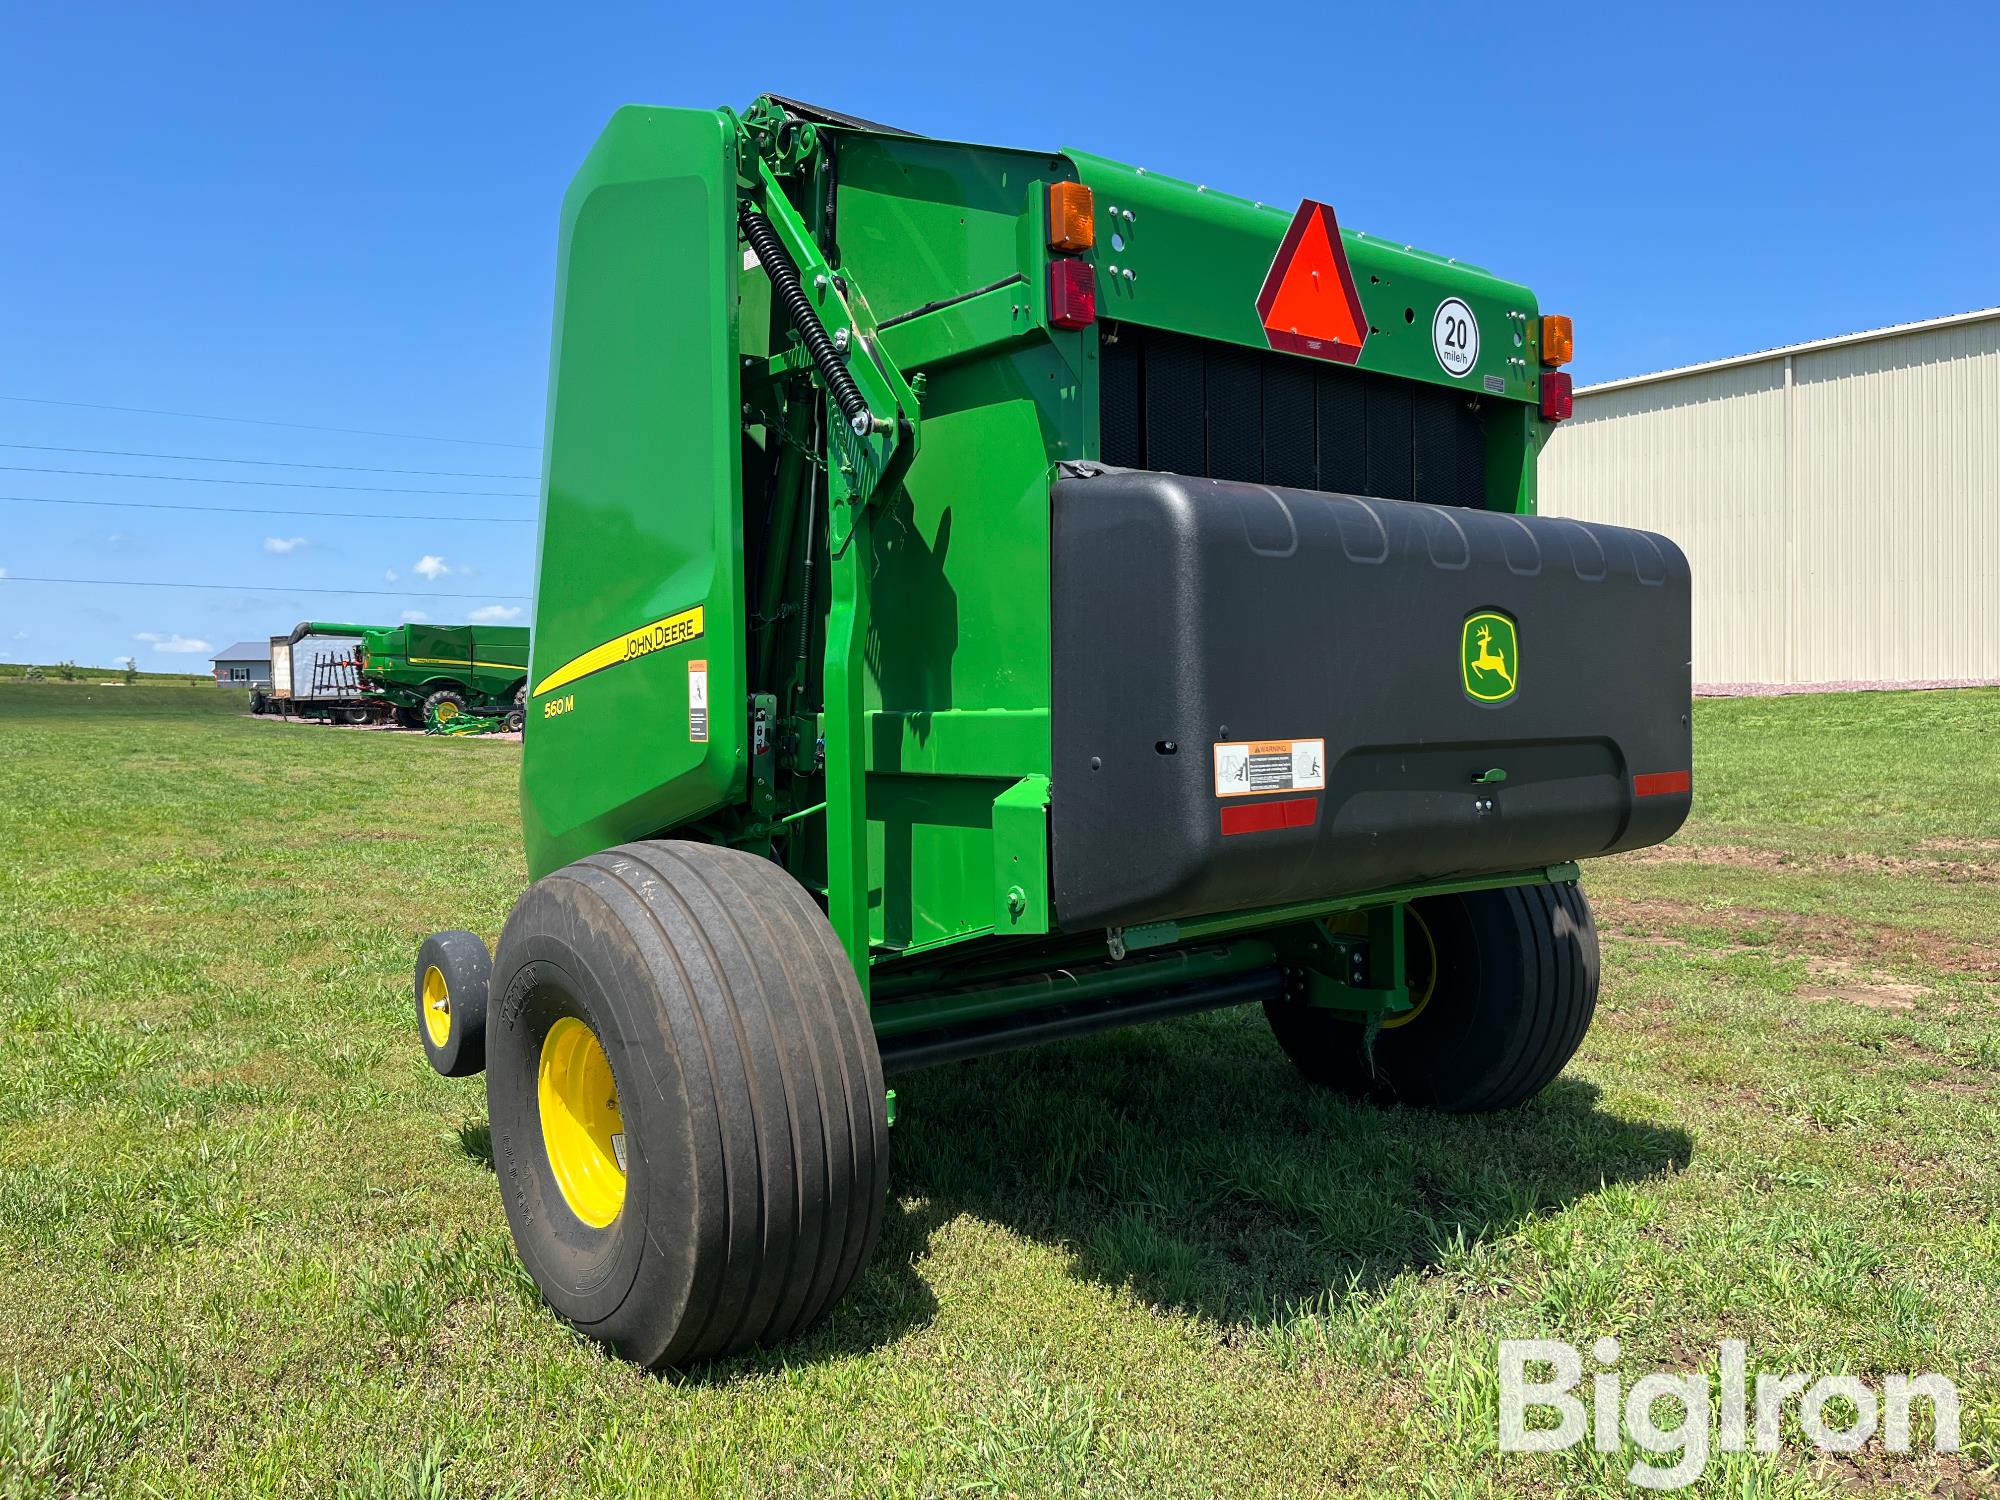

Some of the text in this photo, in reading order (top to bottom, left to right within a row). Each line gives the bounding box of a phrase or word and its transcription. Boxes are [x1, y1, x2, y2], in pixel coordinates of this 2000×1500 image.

[1445, 315, 1467, 350] 20
[1443, 351, 1468, 365] mile/h
[623, 619, 694, 659] JOHN DEERE
[1259, 745, 1287, 753] WARNING
